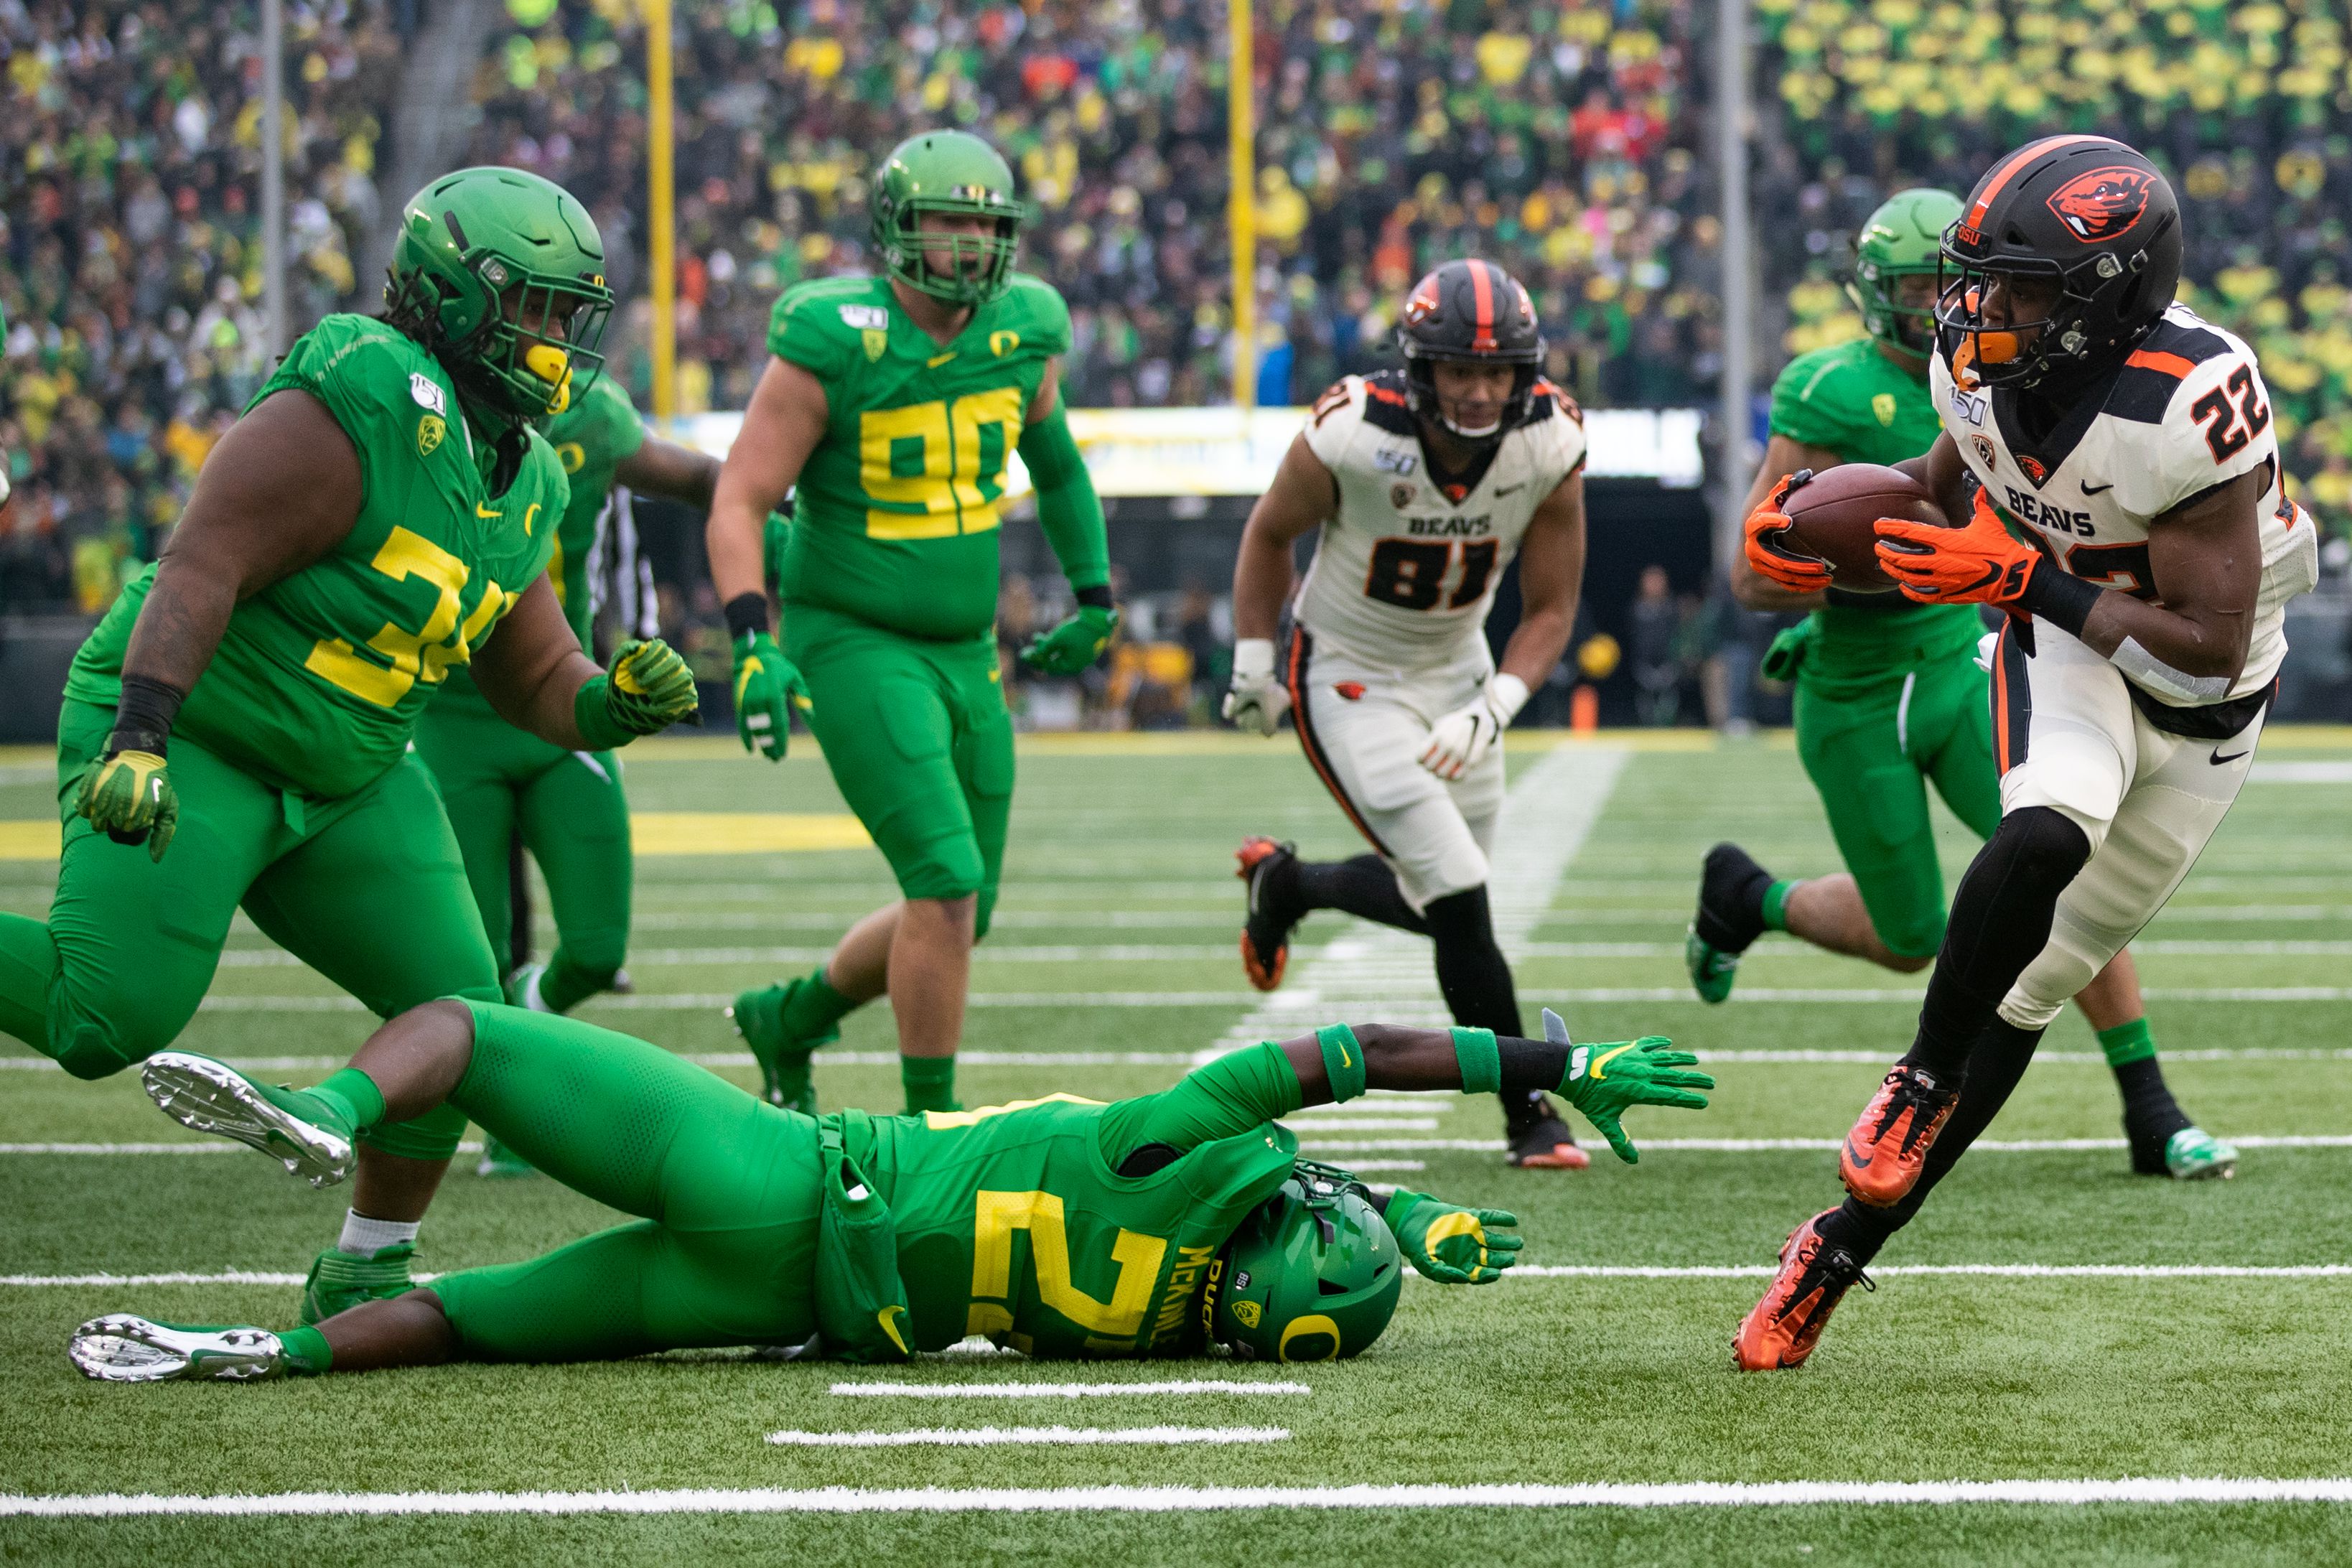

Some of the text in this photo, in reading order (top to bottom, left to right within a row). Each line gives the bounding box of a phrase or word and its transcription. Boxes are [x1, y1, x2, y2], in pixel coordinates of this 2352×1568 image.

[1958, 225, 1982, 246] OSU
[1948, 385, 1989, 428] 150
[2190, 362, 2269, 466] 22
[859, 386, 1025, 540] 90
[1408, 513, 1492, 537] BEAVS
[2005, 484, 2096, 538] BEAVS
[1364, 536, 1500, 612] 81
